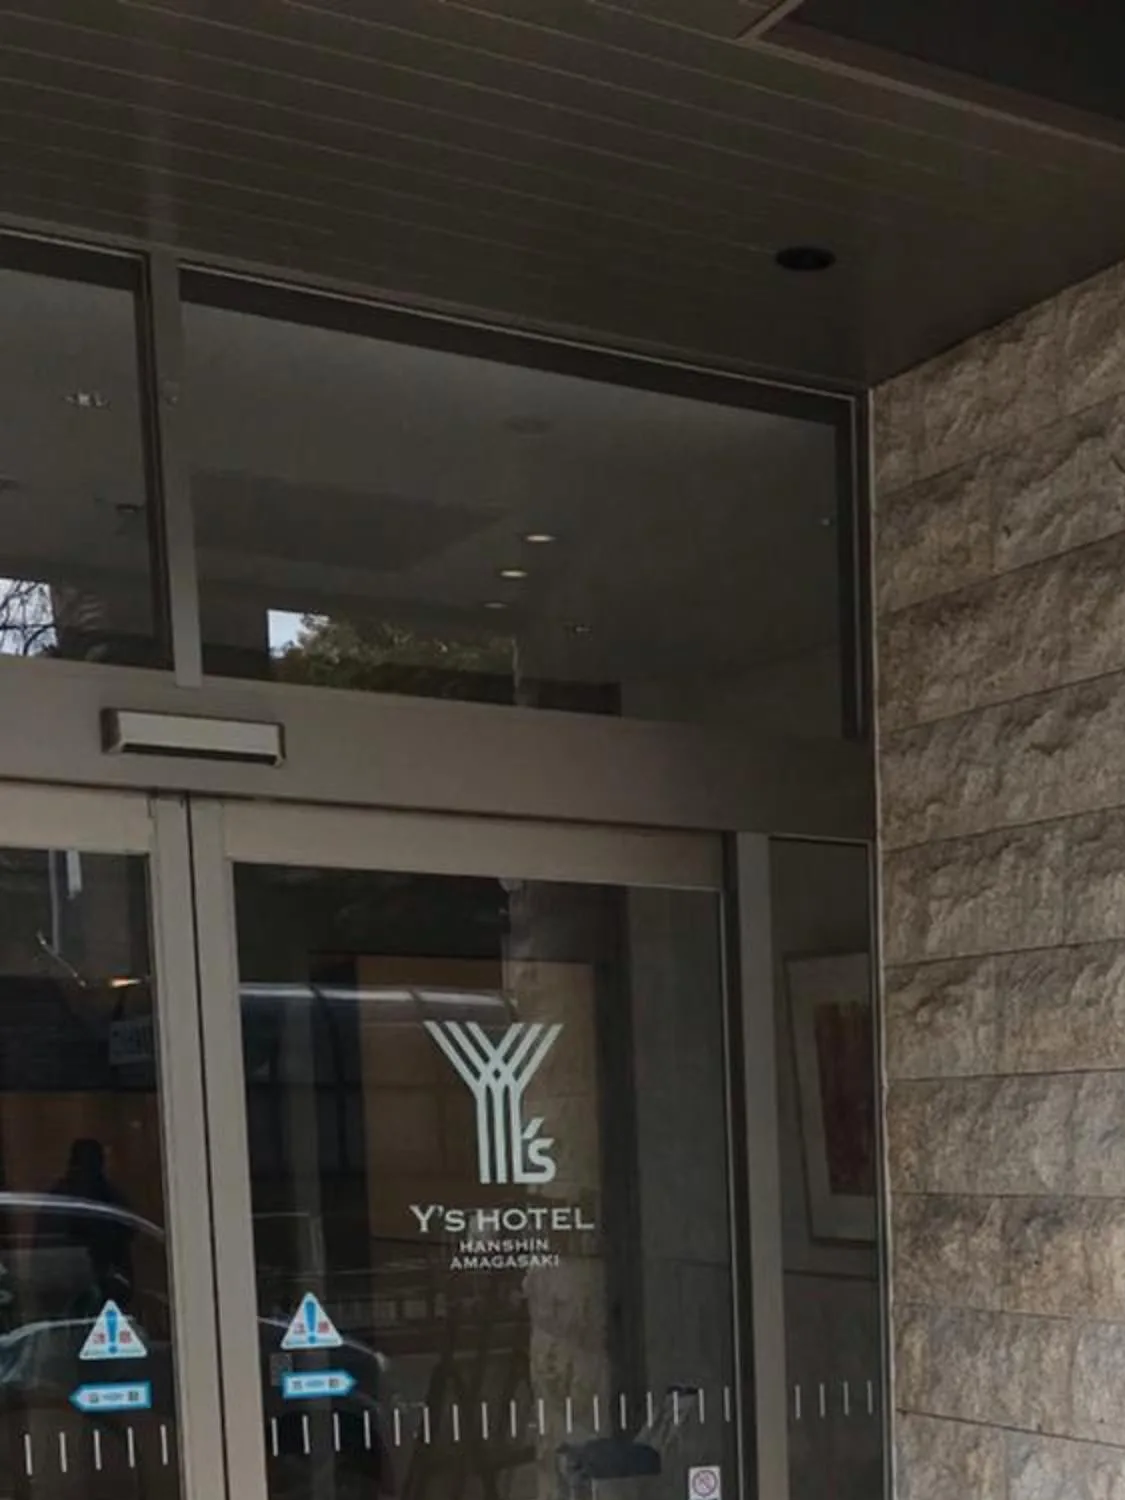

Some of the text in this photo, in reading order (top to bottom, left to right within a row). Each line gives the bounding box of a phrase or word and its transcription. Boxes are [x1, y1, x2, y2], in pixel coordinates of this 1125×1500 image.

[476, 1208, 596, 1231] HOTEL
[458, 1238, 550, 1253] HANSHIN
[450, 1254, 560, 1271] AMAGASAKI
